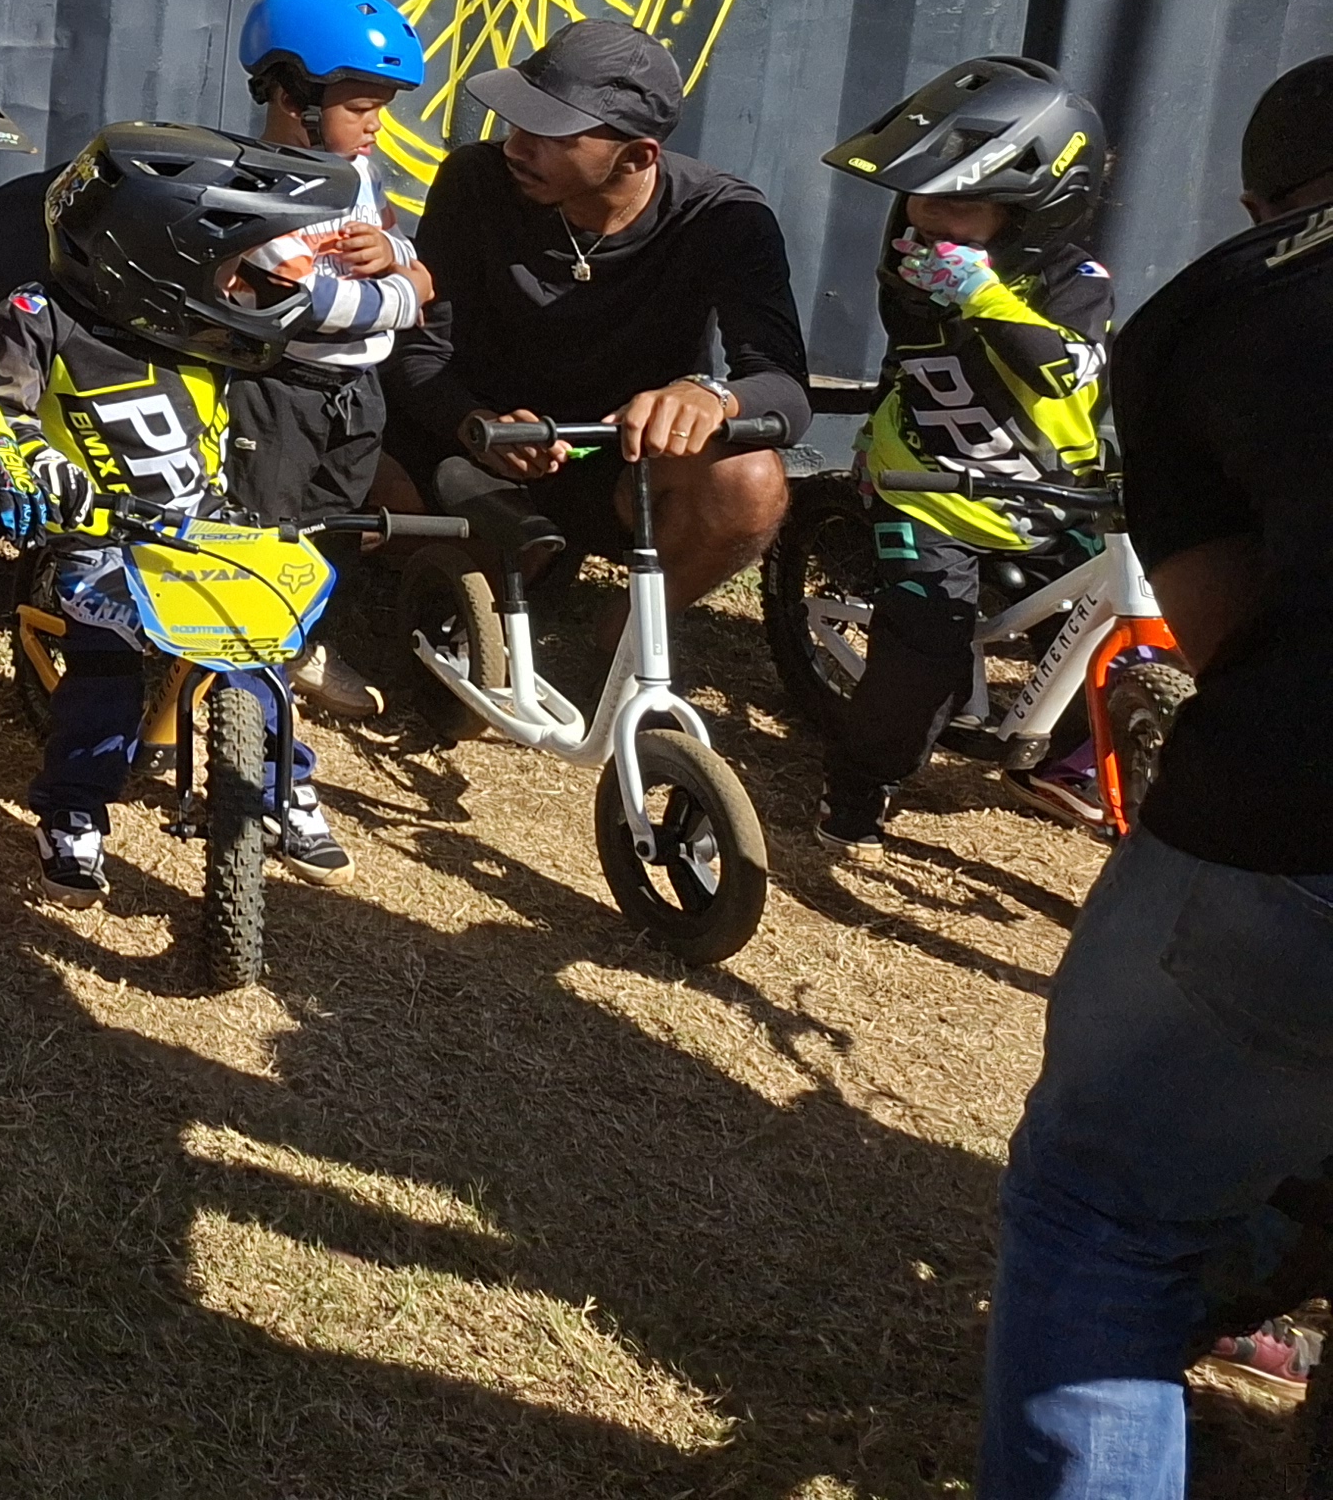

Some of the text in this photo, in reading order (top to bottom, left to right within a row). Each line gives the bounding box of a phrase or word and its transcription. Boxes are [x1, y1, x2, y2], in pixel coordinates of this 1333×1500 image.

[68, 411, 122, 478] BMX
[160, 568, 254, 582] NAYAN
[1013, 592, 1098, 720] COMMENCAL
